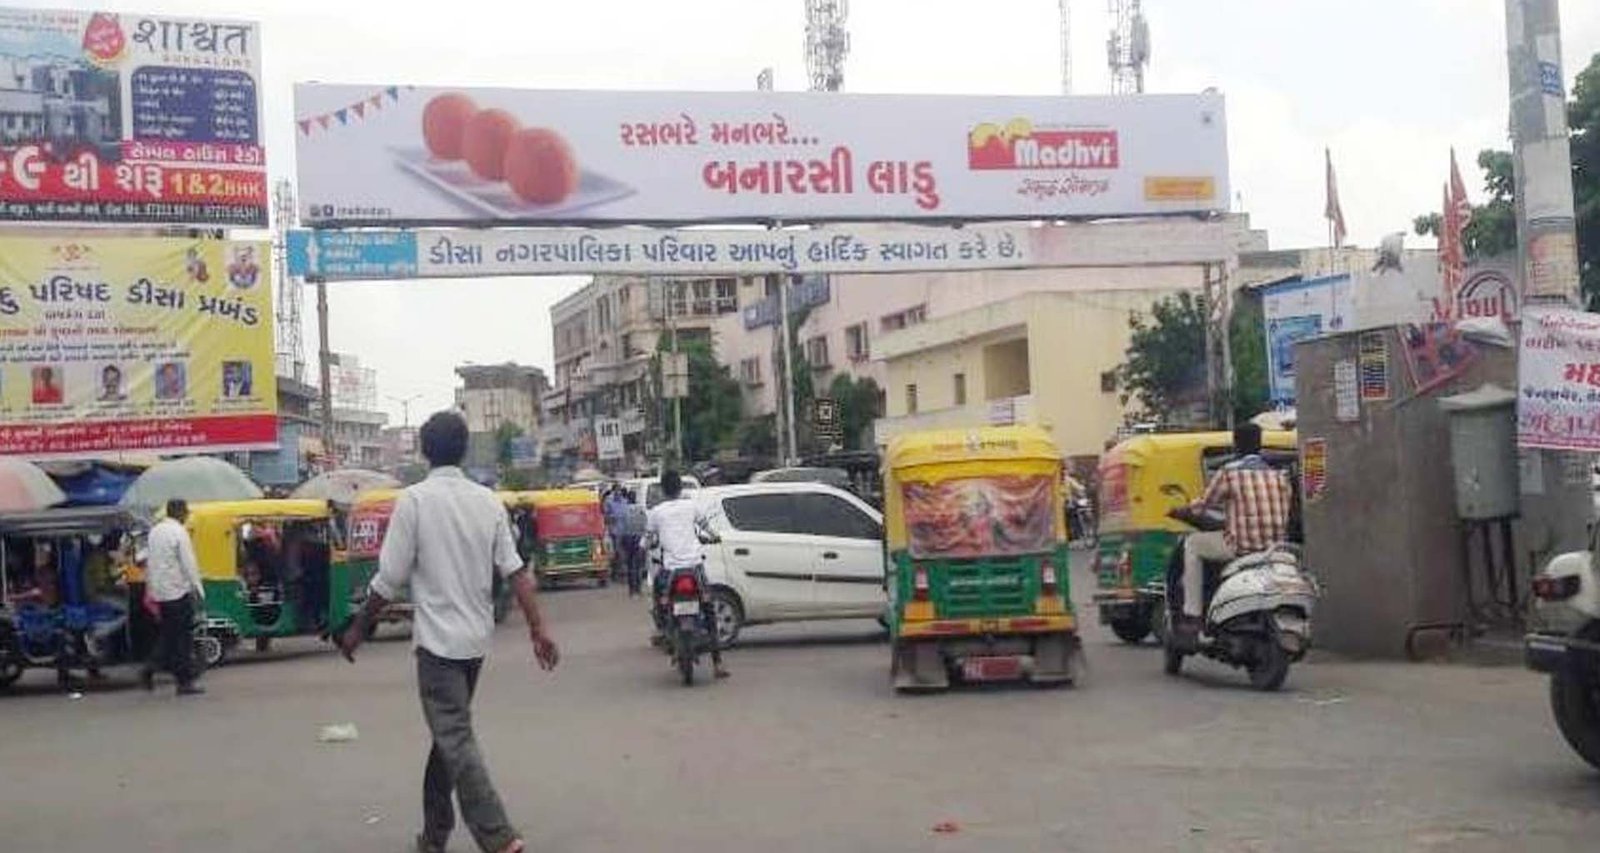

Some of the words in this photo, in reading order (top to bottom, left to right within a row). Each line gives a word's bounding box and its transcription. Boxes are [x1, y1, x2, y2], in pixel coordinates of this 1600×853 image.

[619, 113, 697, 147] રસભરે
[709, 114, 820, 147] મનભરે...
[63, 152, 98, 190] થી
[1015, 137, 1112, 168] Madhvi
[703, 146, 853, 195] બનારસી
[867, 159, 941, 210] લાડુ
[430, 237, 483, 265] ડીસા
[495, 235, 632, 264] નગરપાલિકા
[643, 235, 717, 263] પરિવાર
[729, 239, 799, 270] આપનું
[807, 234, 869, 263] હાર્દિક
[880, 238, 948, 262] સ્વાગત
[957, 235, 989, 260] કરે
[997, 235, 1023, 260] છે.
[29, 275, 111, 303] પરિષદ
[126, 278, 185, 309] ડીસા
[198, 296, 259, 326] પ્રખંડ
